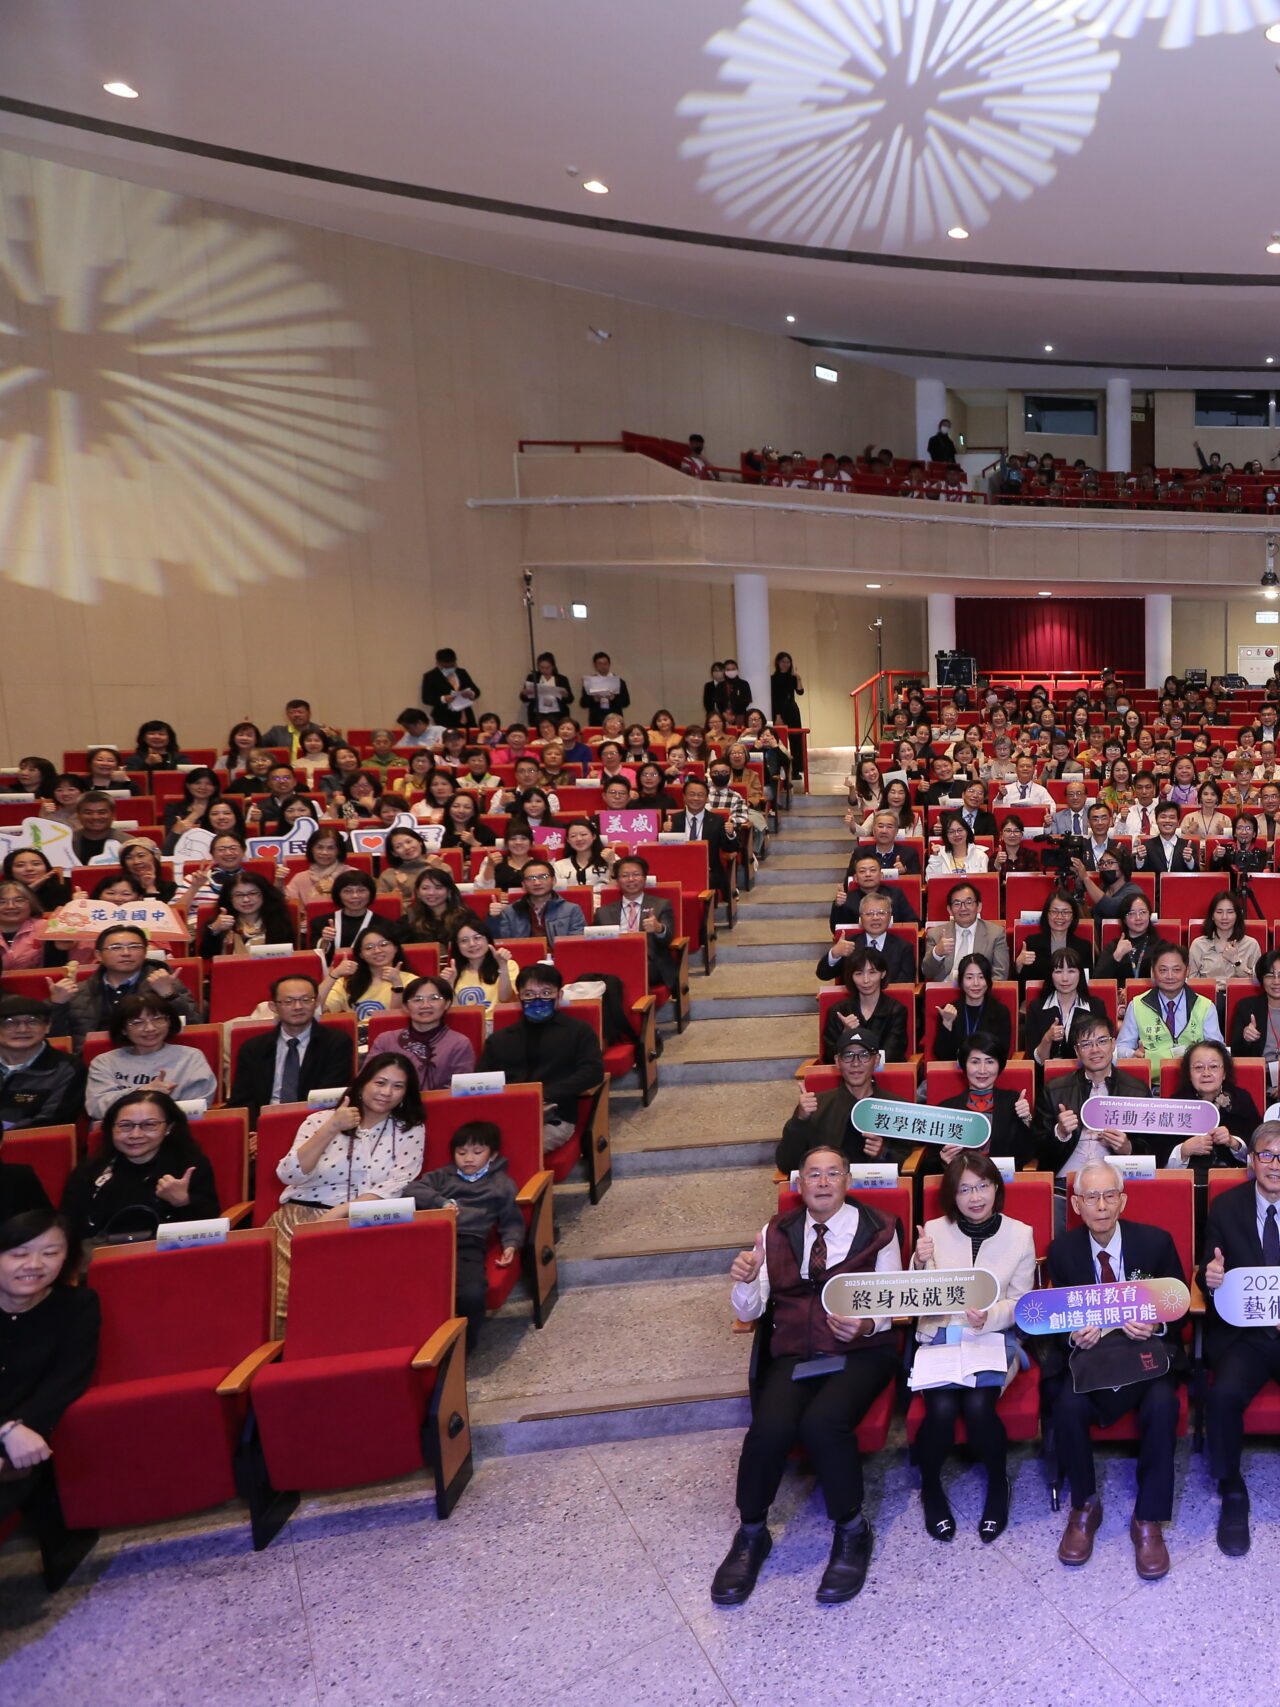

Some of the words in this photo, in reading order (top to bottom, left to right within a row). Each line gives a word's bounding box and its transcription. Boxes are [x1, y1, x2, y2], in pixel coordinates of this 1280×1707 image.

[605, 813, 653, 833] 美感
[91, 909, 165, 921] 花壇國中
[874, 1112, 964, 1140] 教學傑出獎
[1104, 1109, 1193, 1129] 活動奉獻獎
[876, 1278, 909, 1286] Education
[910, 1276, 952, 1284] Contribution
[953, 1274, 975, 1282] Award
[852, 1286, 966, 1311] 終身成就獎
[1066, 1285, 1138, 1308] 藝術教育
[1049, 1303, 1158, 1330] 創造無限可能
